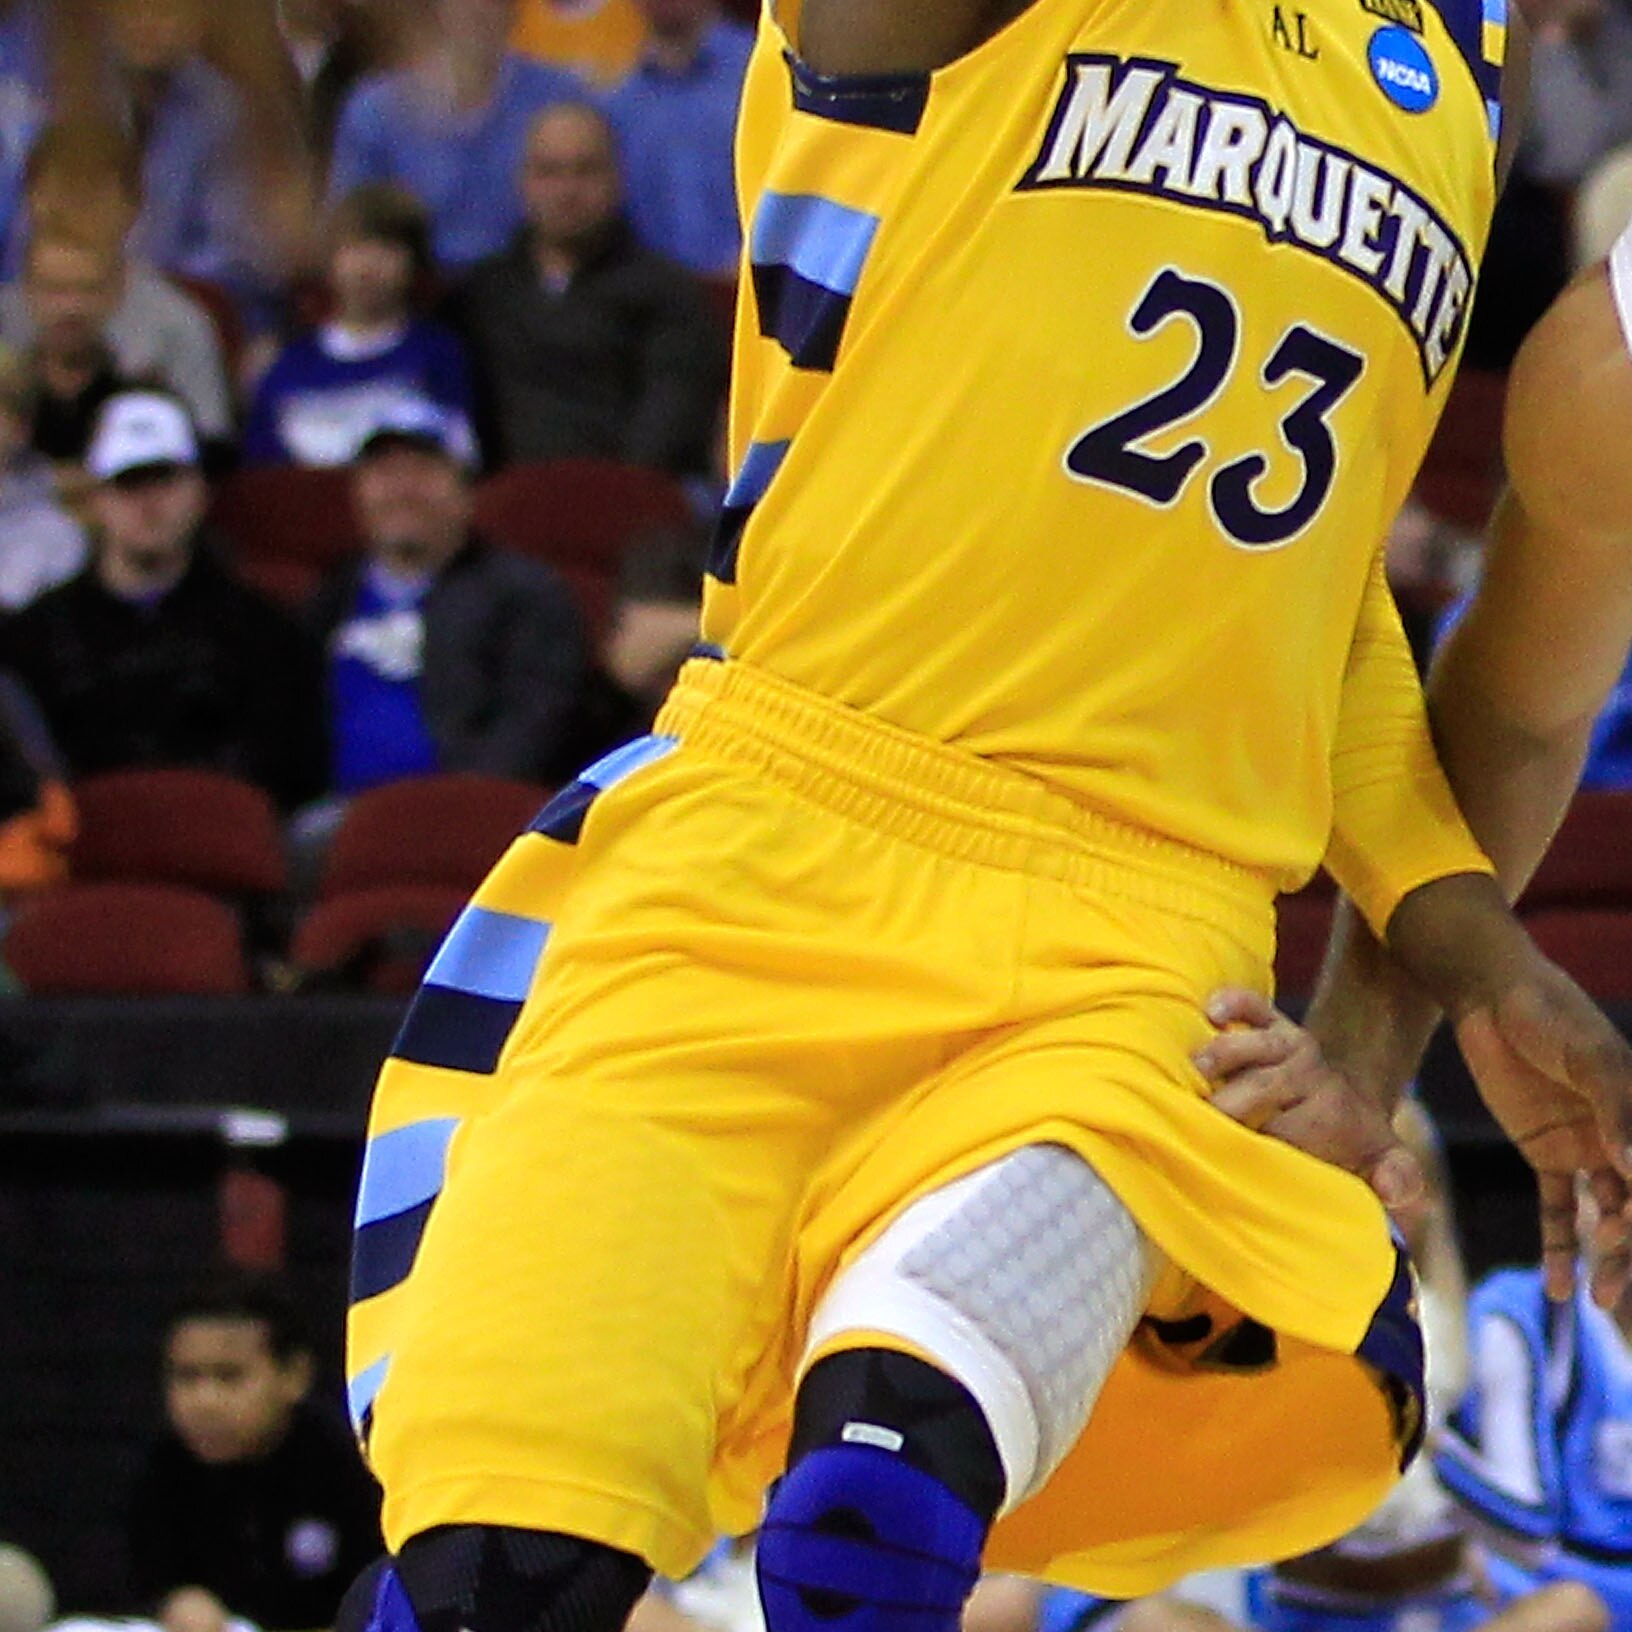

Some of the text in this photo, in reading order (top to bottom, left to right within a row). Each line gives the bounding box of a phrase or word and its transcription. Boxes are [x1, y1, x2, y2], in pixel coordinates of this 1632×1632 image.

[1273, 5, 1319, 59] AL
[1377, 56, 1432, 96] NCAA
[1030, 60, 1470, 382] MARQUETTE
[1066, 267, 1363, 548] 23
